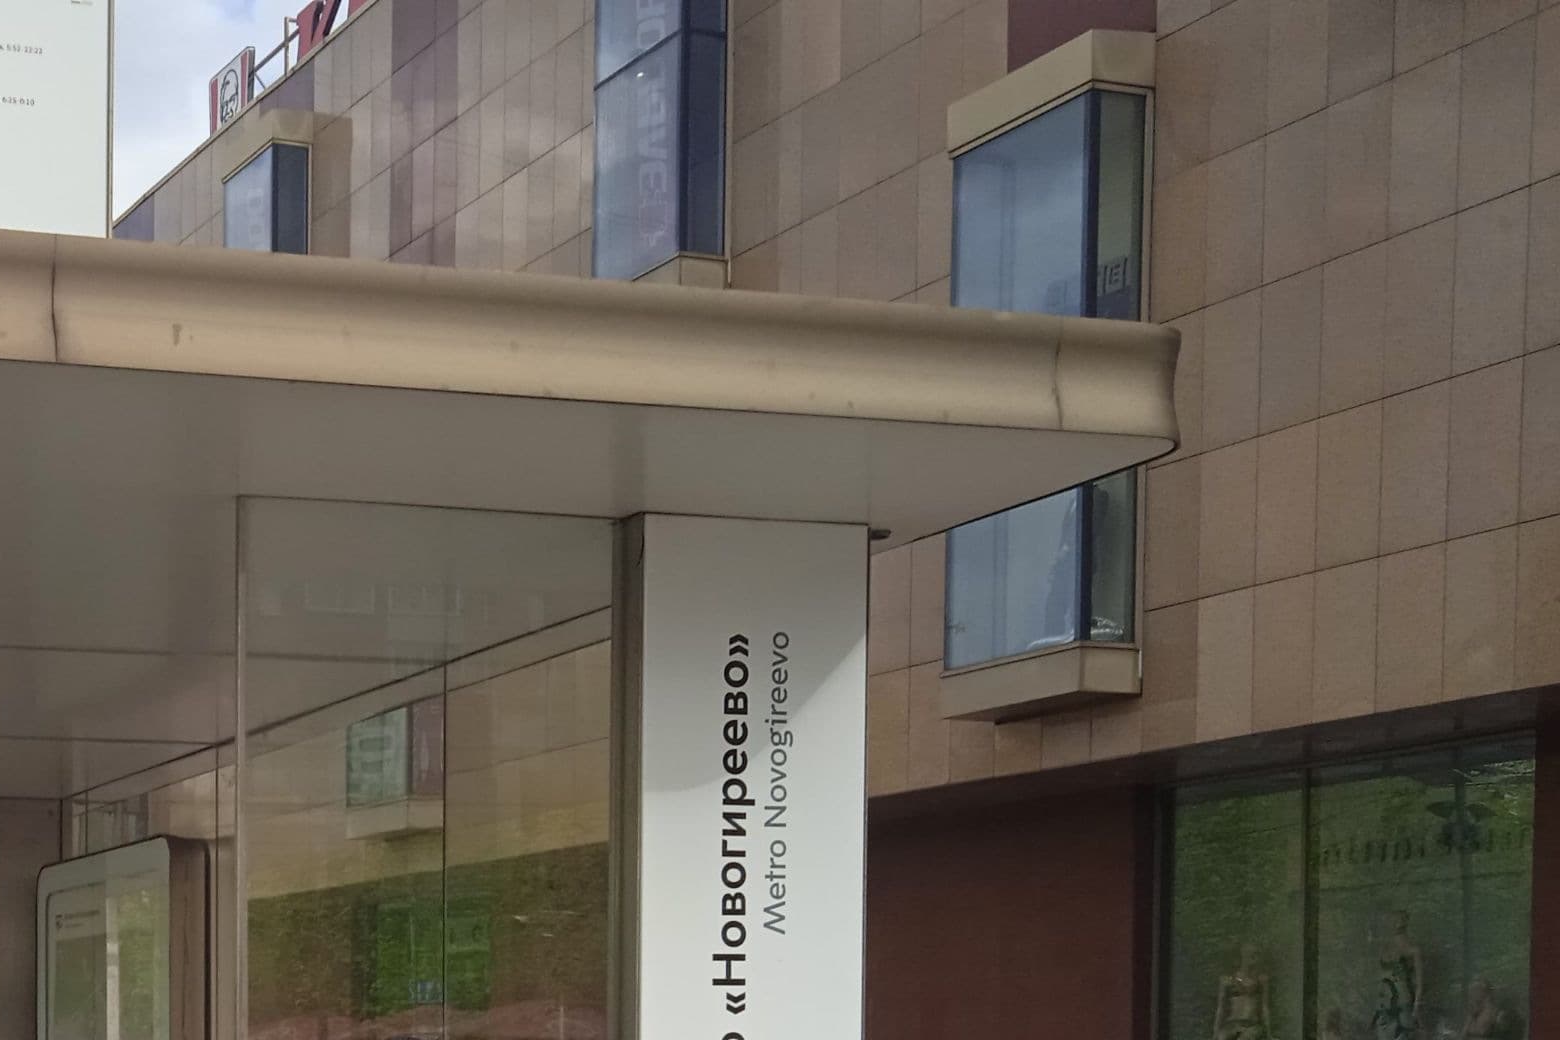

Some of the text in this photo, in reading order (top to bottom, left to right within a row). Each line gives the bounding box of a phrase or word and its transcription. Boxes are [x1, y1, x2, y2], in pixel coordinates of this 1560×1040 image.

[711, 633, 756, 1016] «Новогиреево»
[763, 631, 794, 936] Metro Novogireevo
